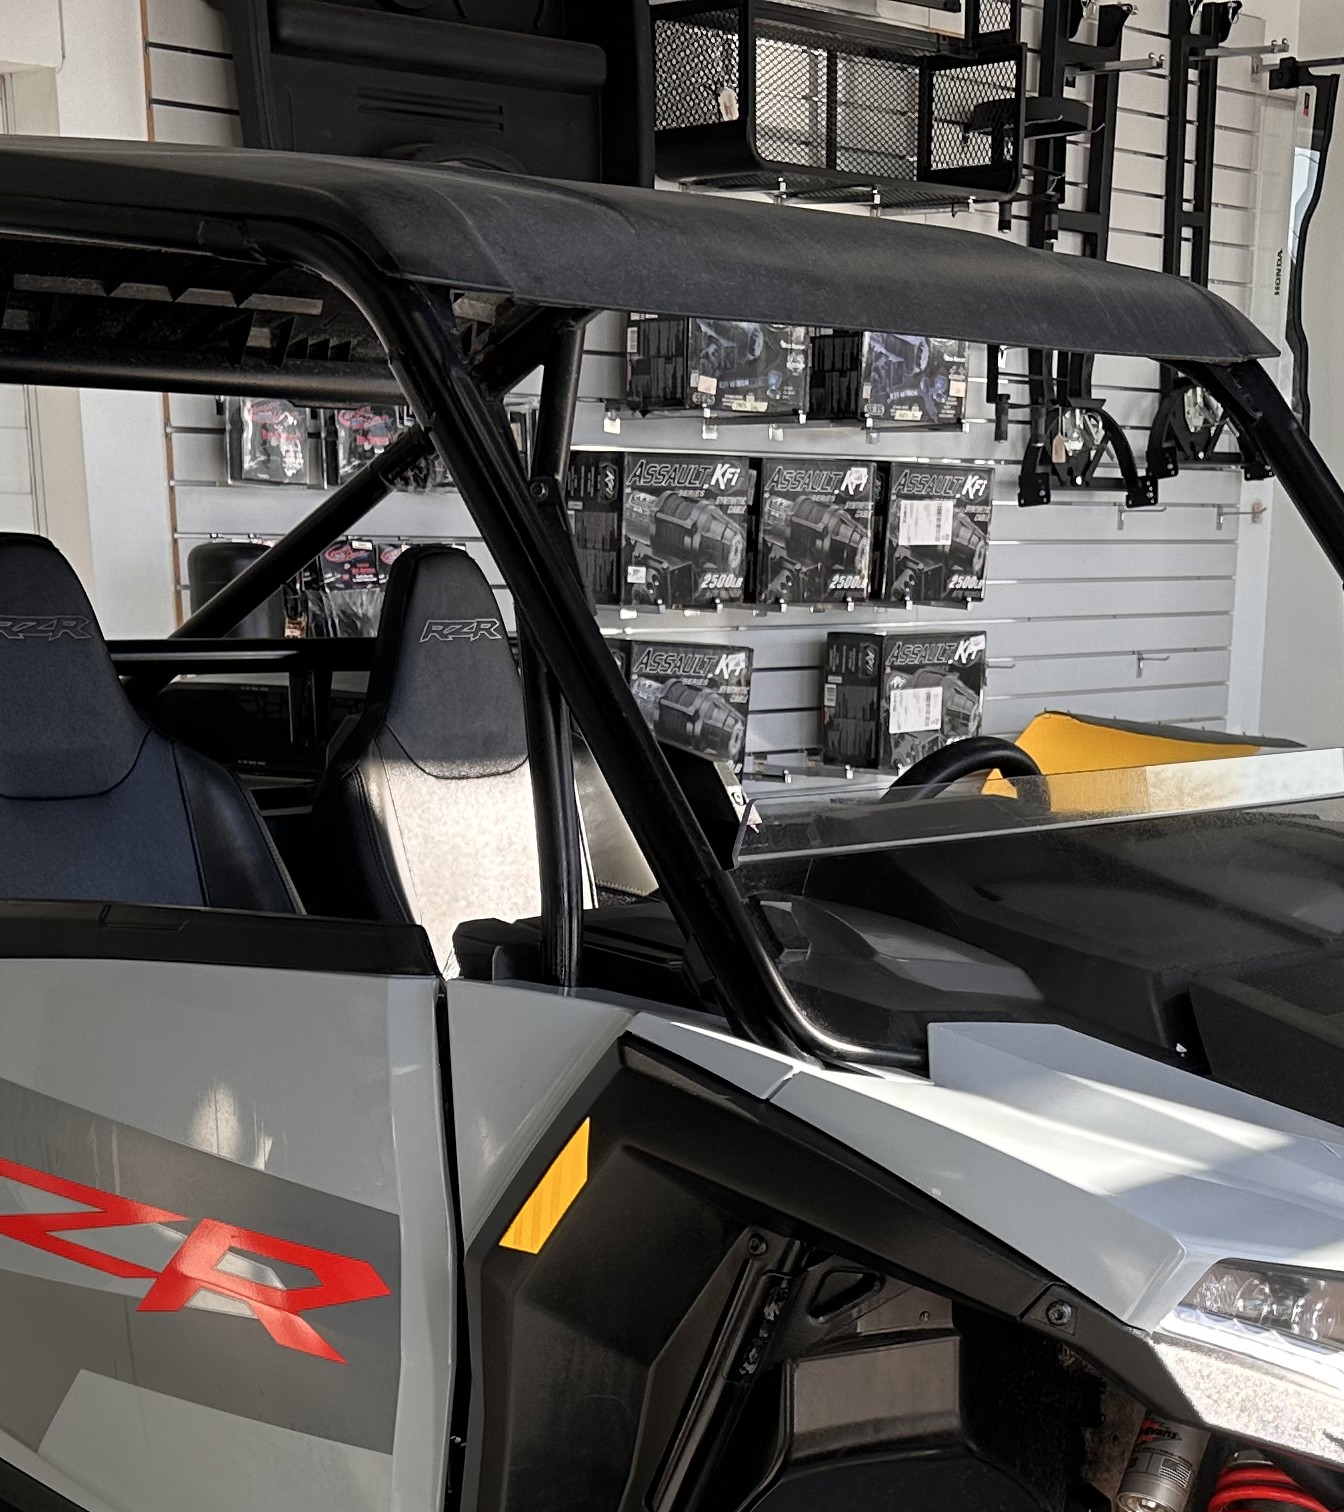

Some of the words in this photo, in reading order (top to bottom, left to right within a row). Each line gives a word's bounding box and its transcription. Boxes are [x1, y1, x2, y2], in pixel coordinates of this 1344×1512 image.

[625, 458, 714, 487] ASSAULT
[763, 465, 844, 492] ASSAULT
[891, 469, 965, 497] ASSAULT
[419, 618, 503, 643] RZR
[632, 647, 719, 677] ASSAULT
[884, 641, 957, 666] ASSAULT
